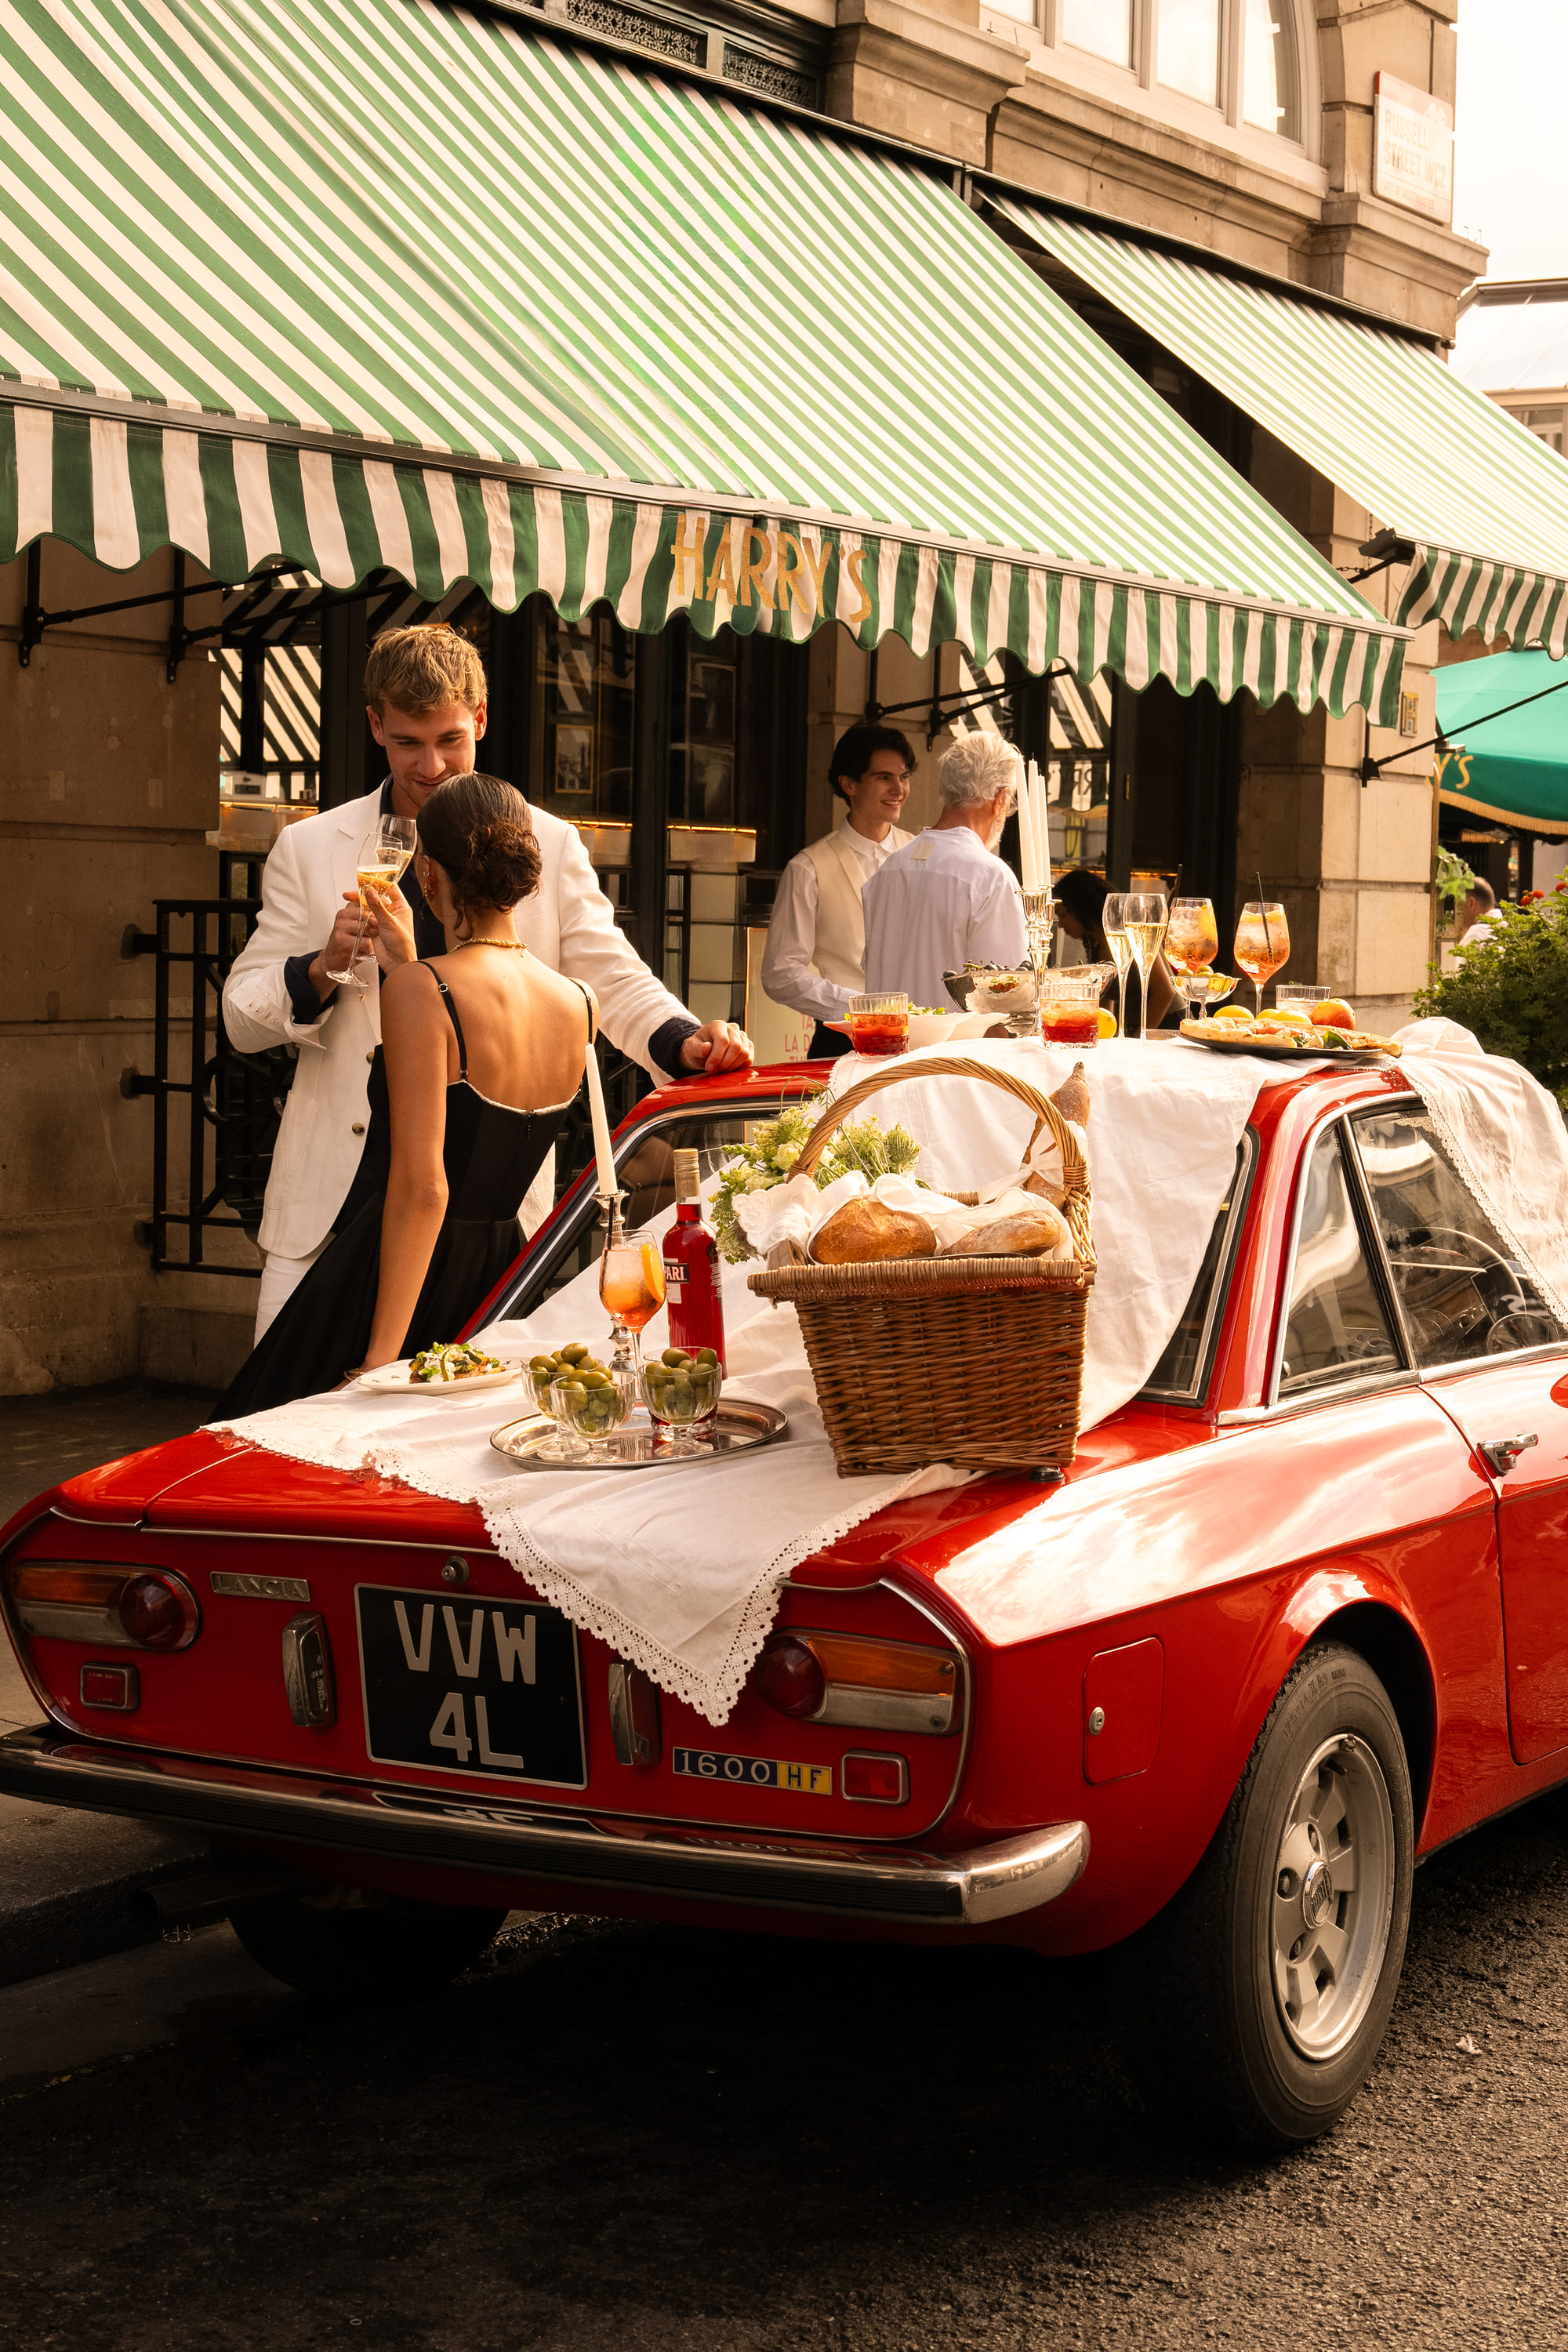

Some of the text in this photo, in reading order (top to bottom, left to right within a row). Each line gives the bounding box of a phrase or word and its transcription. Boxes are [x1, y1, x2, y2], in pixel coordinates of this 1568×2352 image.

[1385, 108, 1429, 151] RUSSELL
[1385, 140, 1446, 188] STREET WC2
[670, 513, 872, 623] HARRY'S
[785, 1033, 811, 1052] LA D
[215, 1575, 306, 1599] LANCIA
[394, 1600, 536, 1685] VVW
[430, 1693, 524, 1769] 4L
[681, 1751, 822, 1791] 1600 HF
